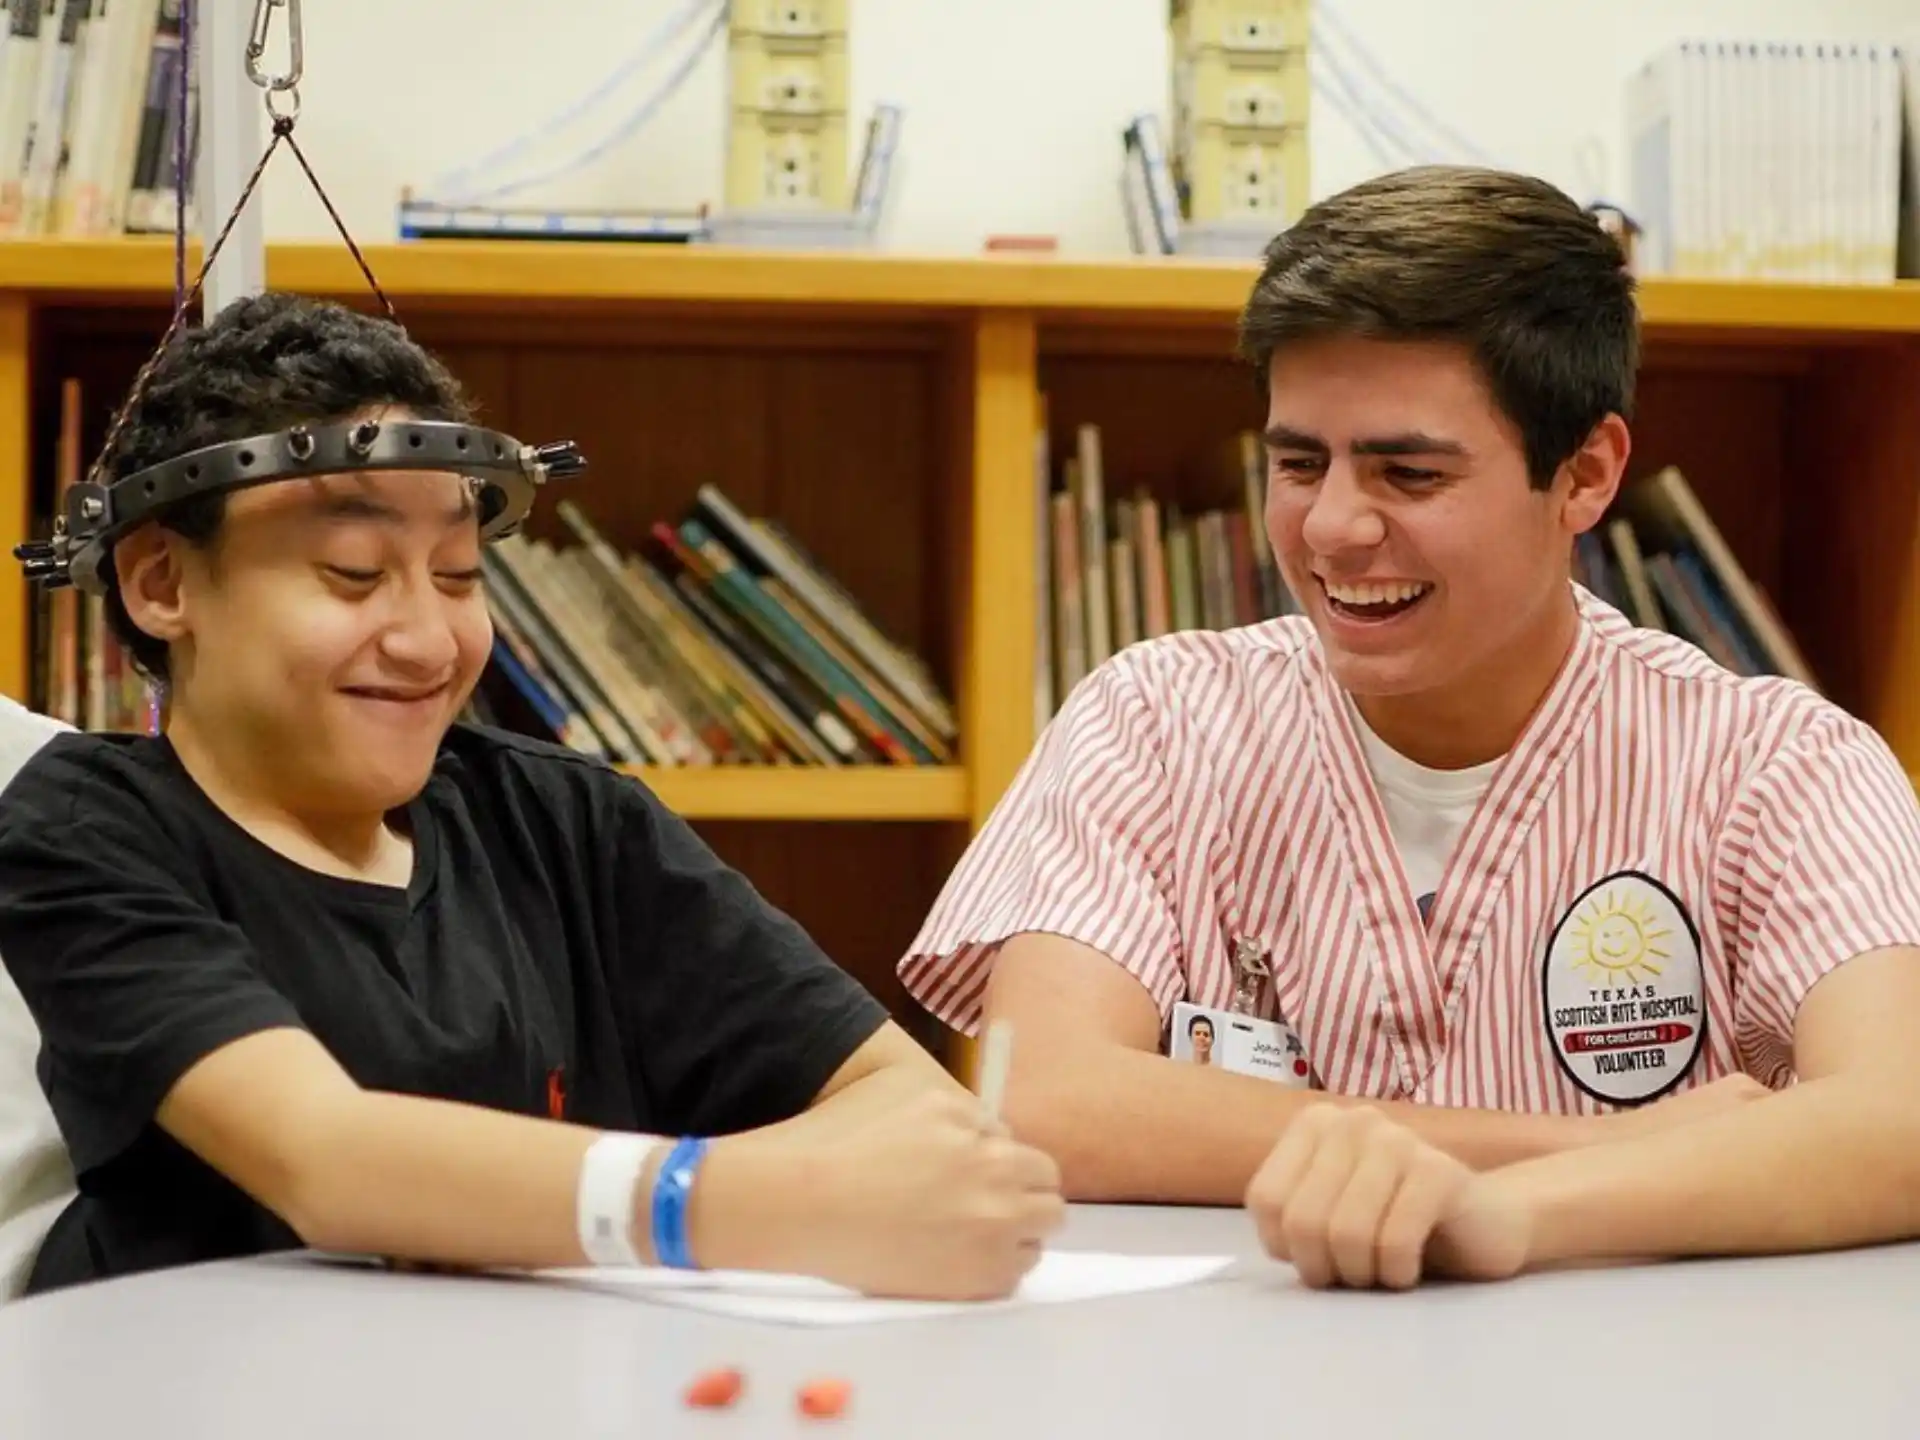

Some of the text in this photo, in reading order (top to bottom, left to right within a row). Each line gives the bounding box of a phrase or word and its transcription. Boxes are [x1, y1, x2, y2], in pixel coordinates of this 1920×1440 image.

[1590, 985, 1656, 1002] TEXAS
[1555, 995, 1698, 1028] SCOTTISH RITE HOSPITAL
[1585, 1029, 1657, 1046] FOR CHILDREN
[1594, 1049, 1666, 1074] VOLUNTEER
